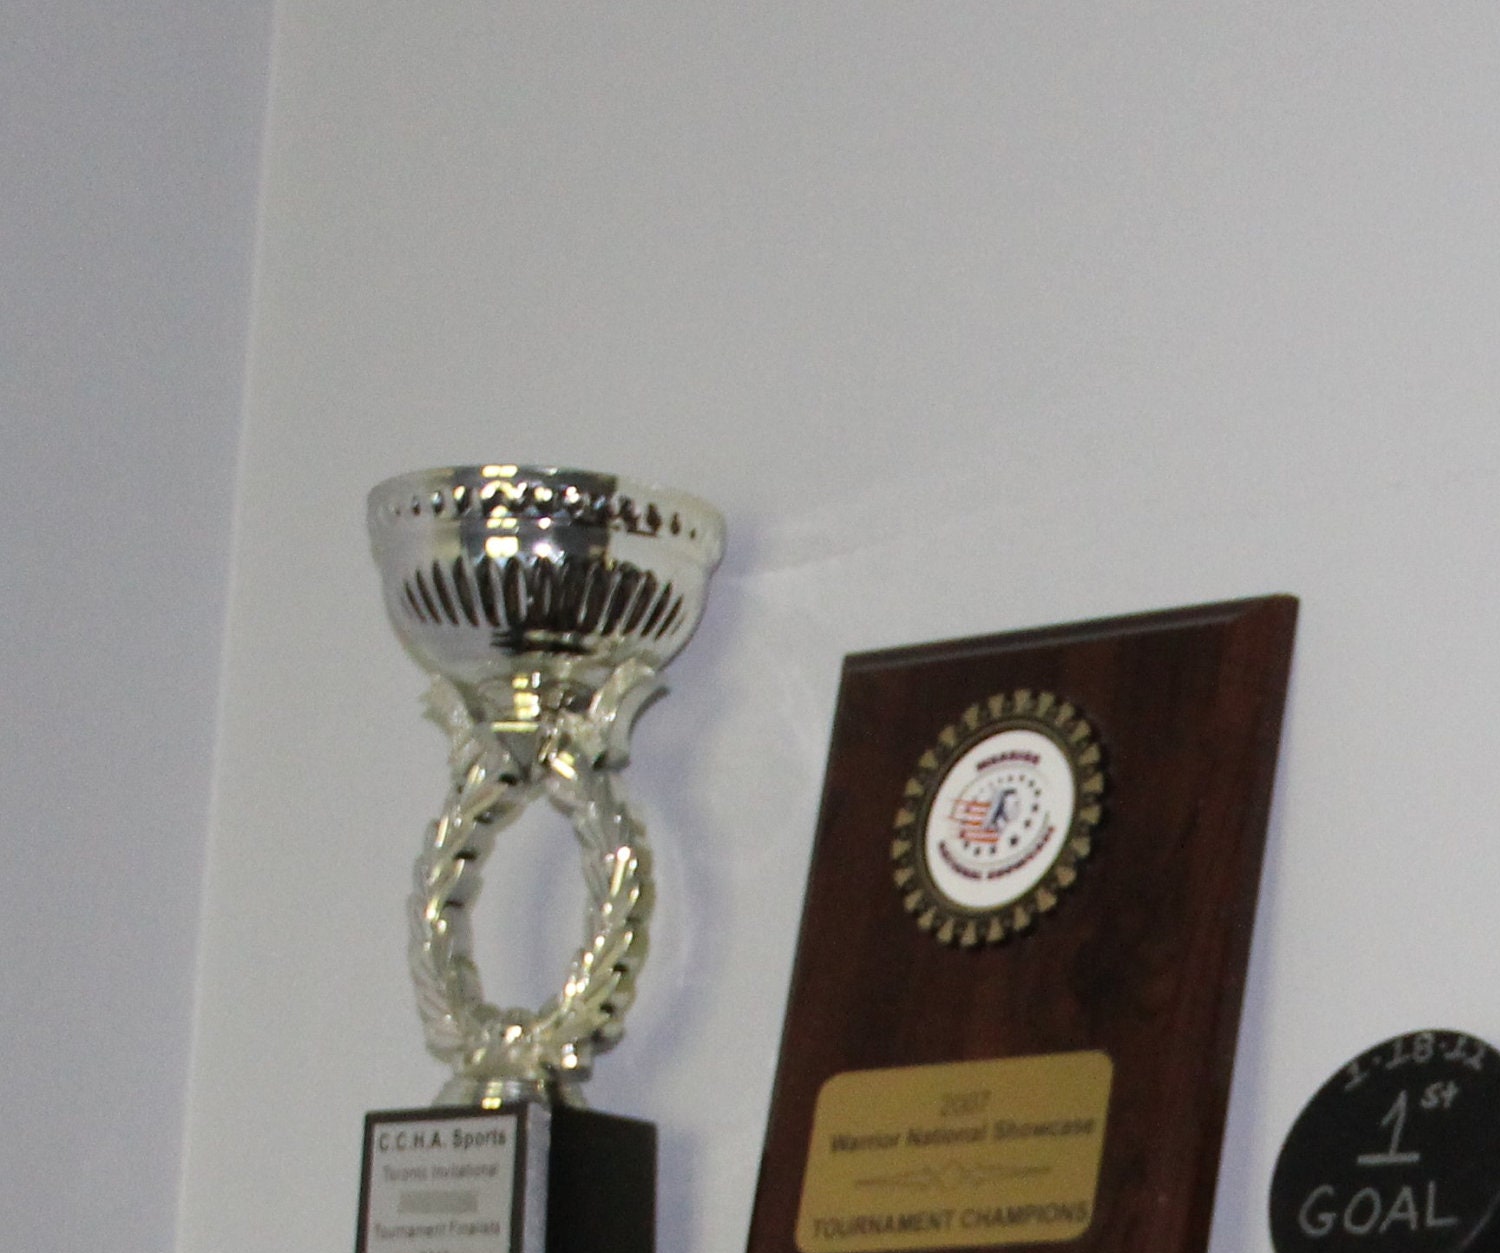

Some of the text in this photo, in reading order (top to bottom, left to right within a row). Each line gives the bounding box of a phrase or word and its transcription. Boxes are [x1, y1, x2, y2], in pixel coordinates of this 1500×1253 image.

[452, 1127, 507, 1151] Sports
[905, 1124, 988, 1147] National
[992, 1116, 1096, 1142] Showcase
[813, 1200, 1090, 1240] TOURNAMENT CHAMPIONS
[1298, 1180, 1459, 1238] GOAL
